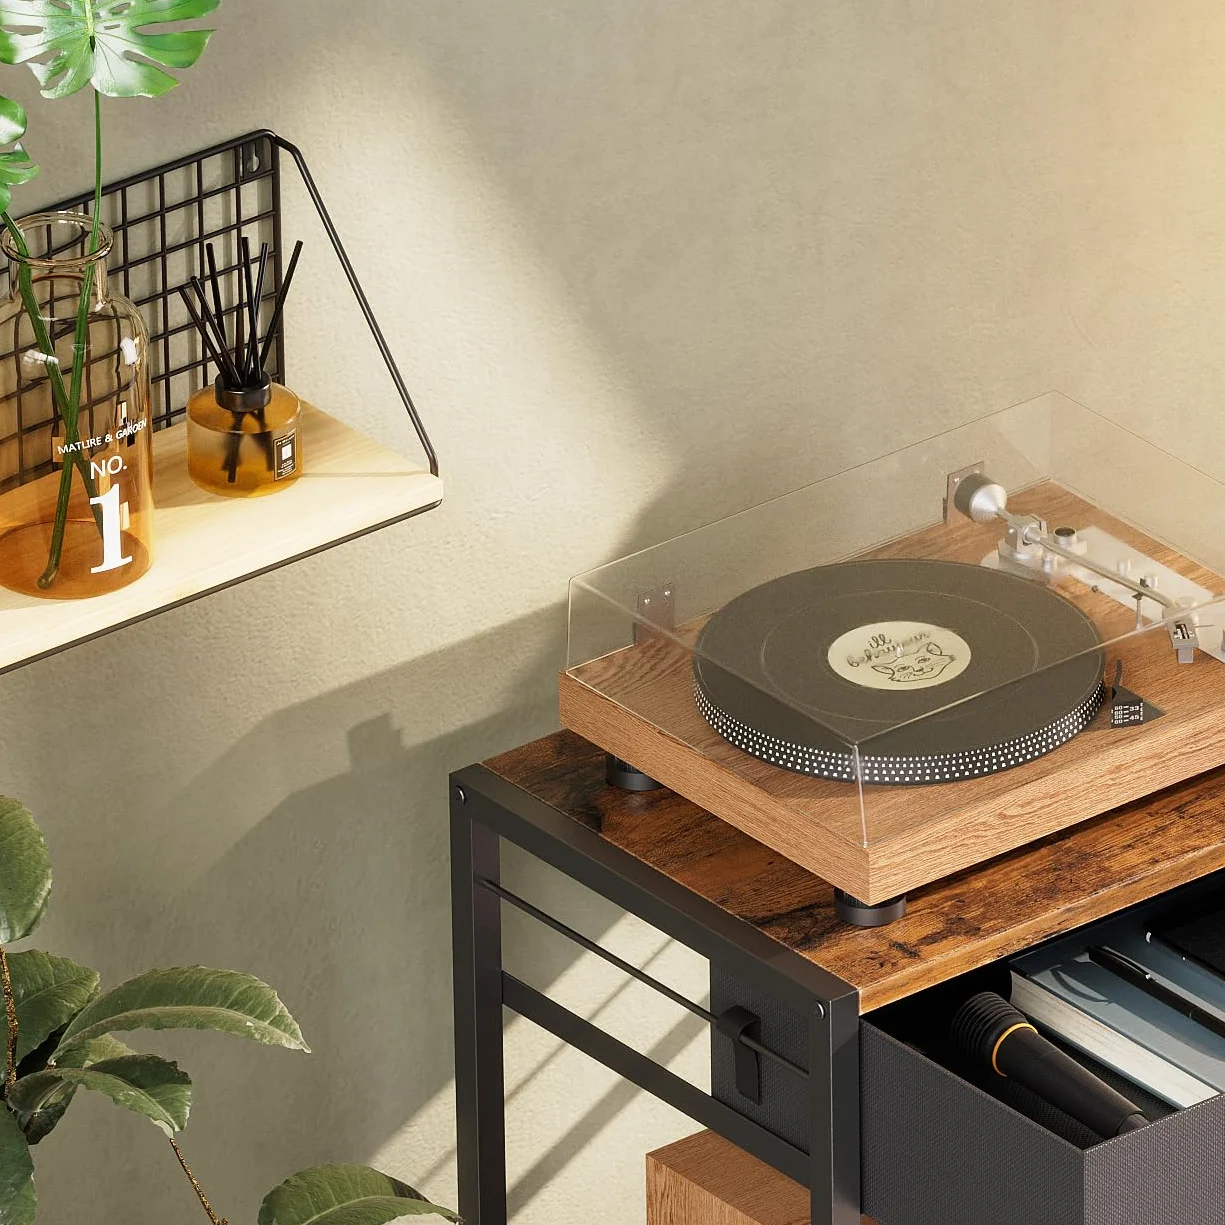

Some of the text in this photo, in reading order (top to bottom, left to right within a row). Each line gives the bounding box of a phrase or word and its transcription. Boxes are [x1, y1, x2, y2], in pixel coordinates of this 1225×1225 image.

[105, 434, 113, 443] &
[90, 455, 128, 480] NO.
[89, 483, 133, 574] 1
